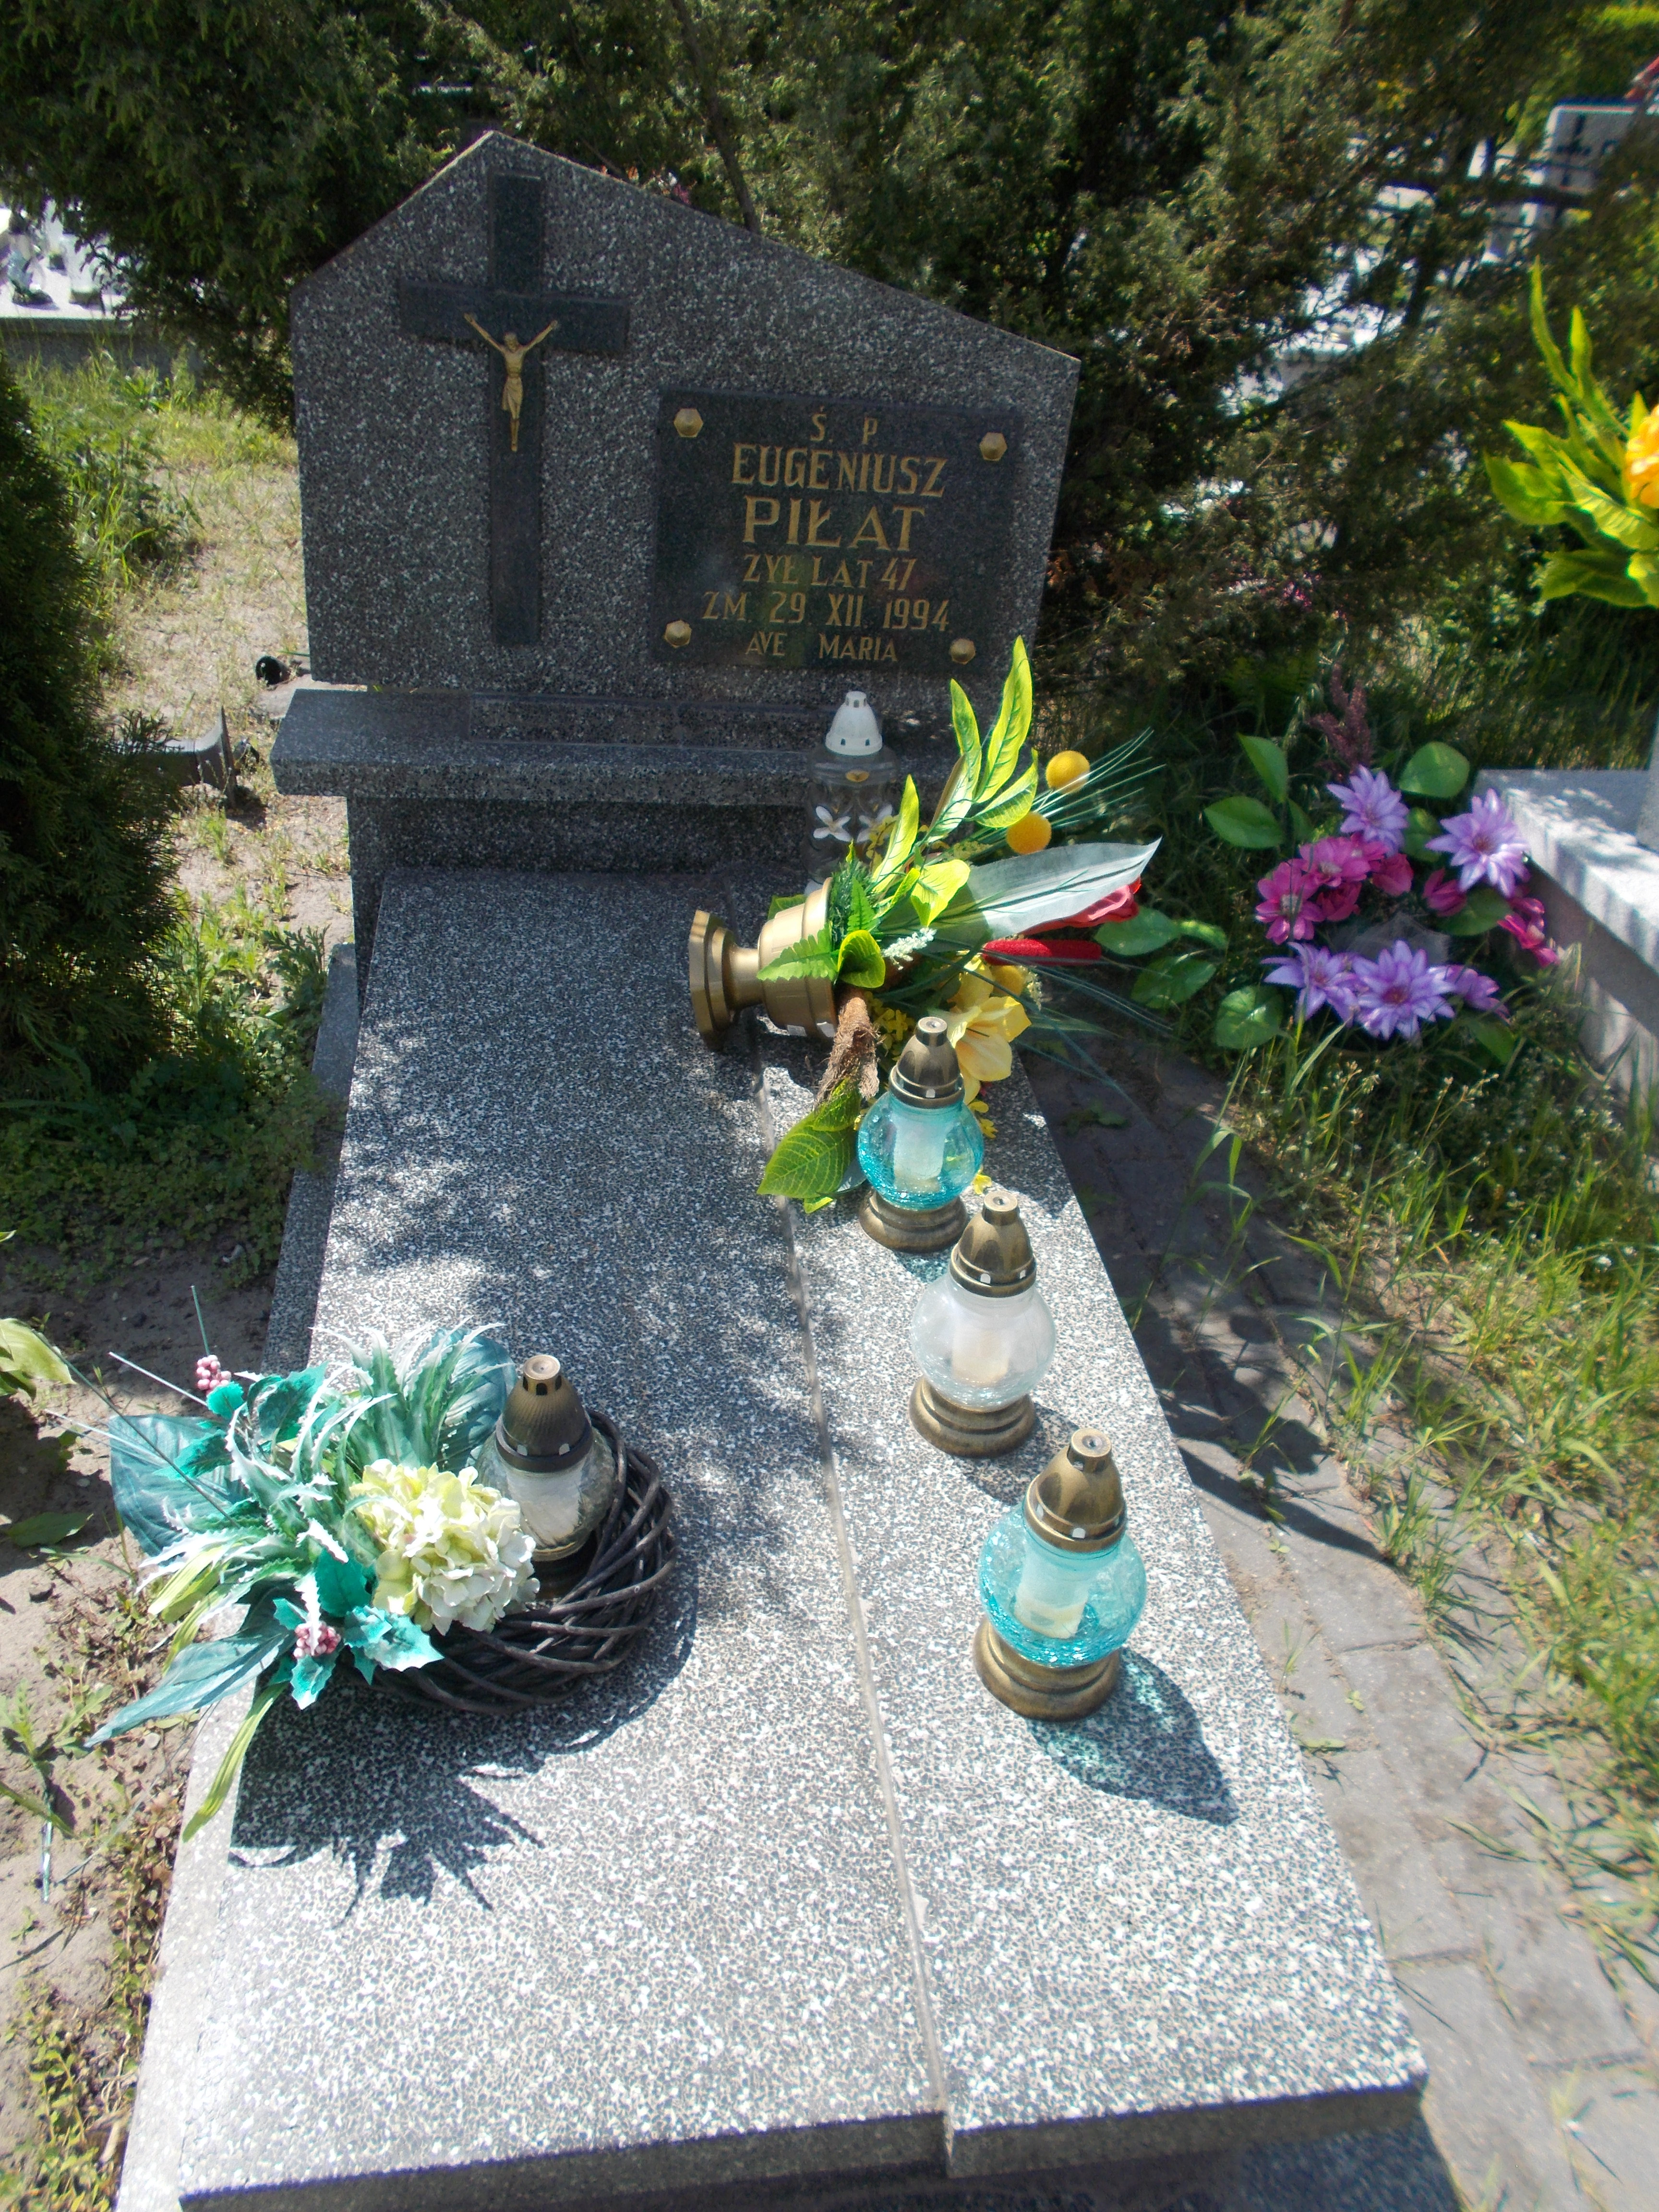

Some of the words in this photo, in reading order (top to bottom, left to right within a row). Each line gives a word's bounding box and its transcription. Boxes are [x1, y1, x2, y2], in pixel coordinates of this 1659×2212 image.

[731, 442, 949, 498] EUGENIUSZ
[742, 494, 926, 552] PIŁAT
[810, 555, 874, 589] LAT
[880, 556, 918, 591] 47
[745, 630, 788, 656] AVE
[818, 632, 898, 662] MARIA
